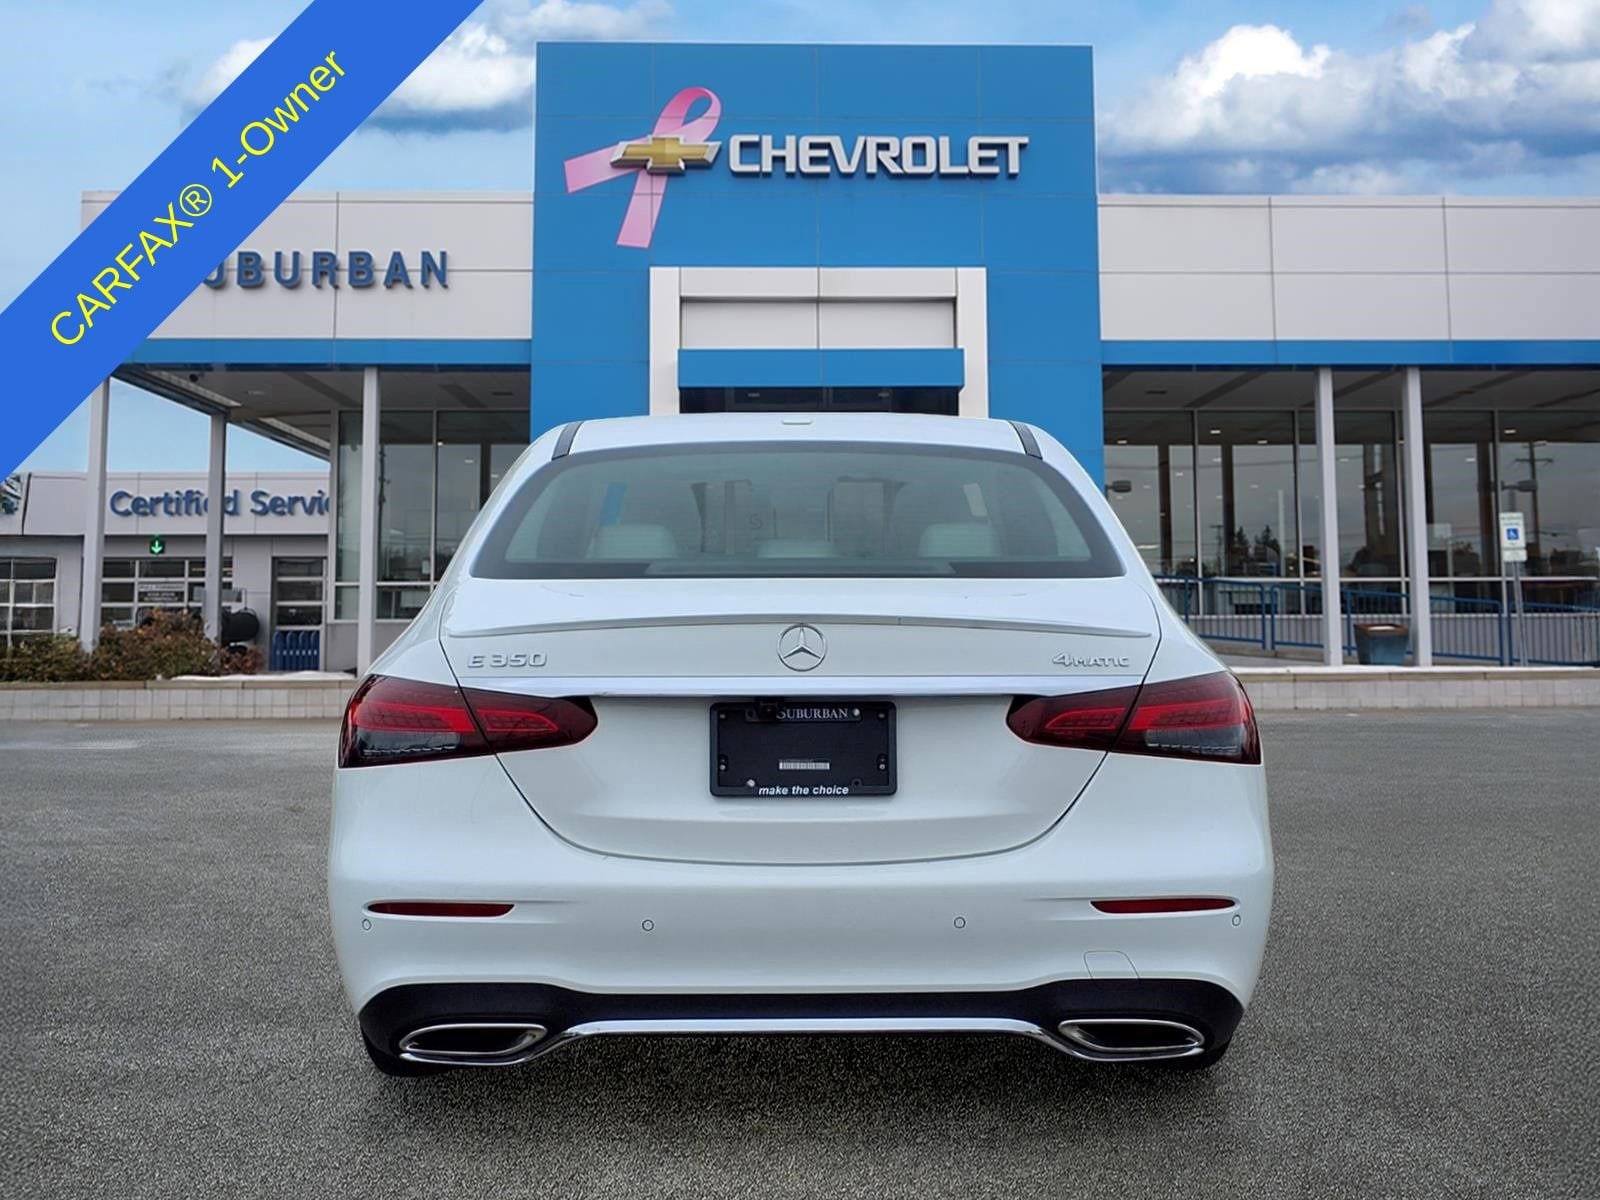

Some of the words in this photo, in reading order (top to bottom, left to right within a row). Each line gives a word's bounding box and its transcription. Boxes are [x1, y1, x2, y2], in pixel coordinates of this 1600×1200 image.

[729, 135, 1029, 174] CHEVROLET
[467, 654, 486, 669] E
[489, 653, 548, 668] 350
[1052, 652, 1131, 668] 4MATIC
[776, 707, 849, 720] SUBURBAN
[758, 785, 789, 796] make
[791, 785, 810, 796] the
[812, 785, 850, 796] choice
